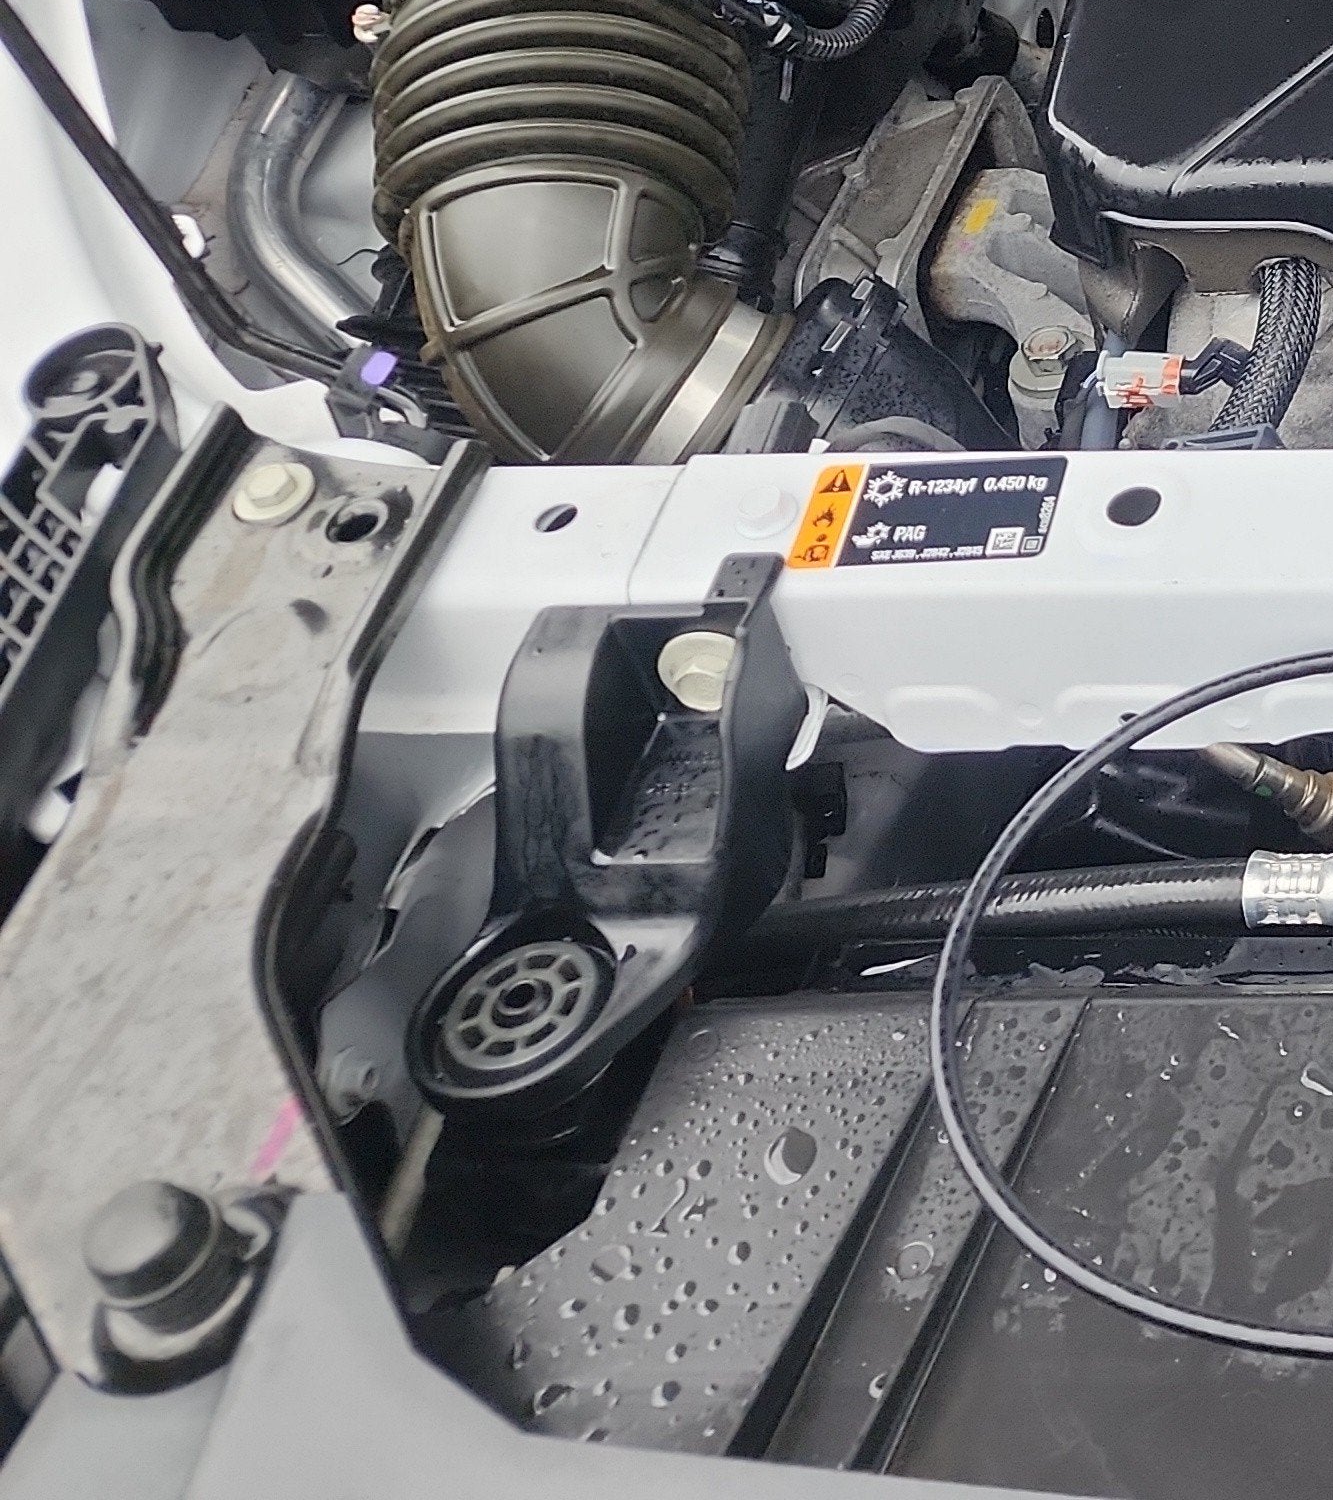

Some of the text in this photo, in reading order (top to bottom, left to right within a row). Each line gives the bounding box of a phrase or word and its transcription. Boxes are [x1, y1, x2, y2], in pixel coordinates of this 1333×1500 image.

[907, 474, 1049, 496] R-1234yf 0.450 kg
[892, 525, 927, 543] PAG
